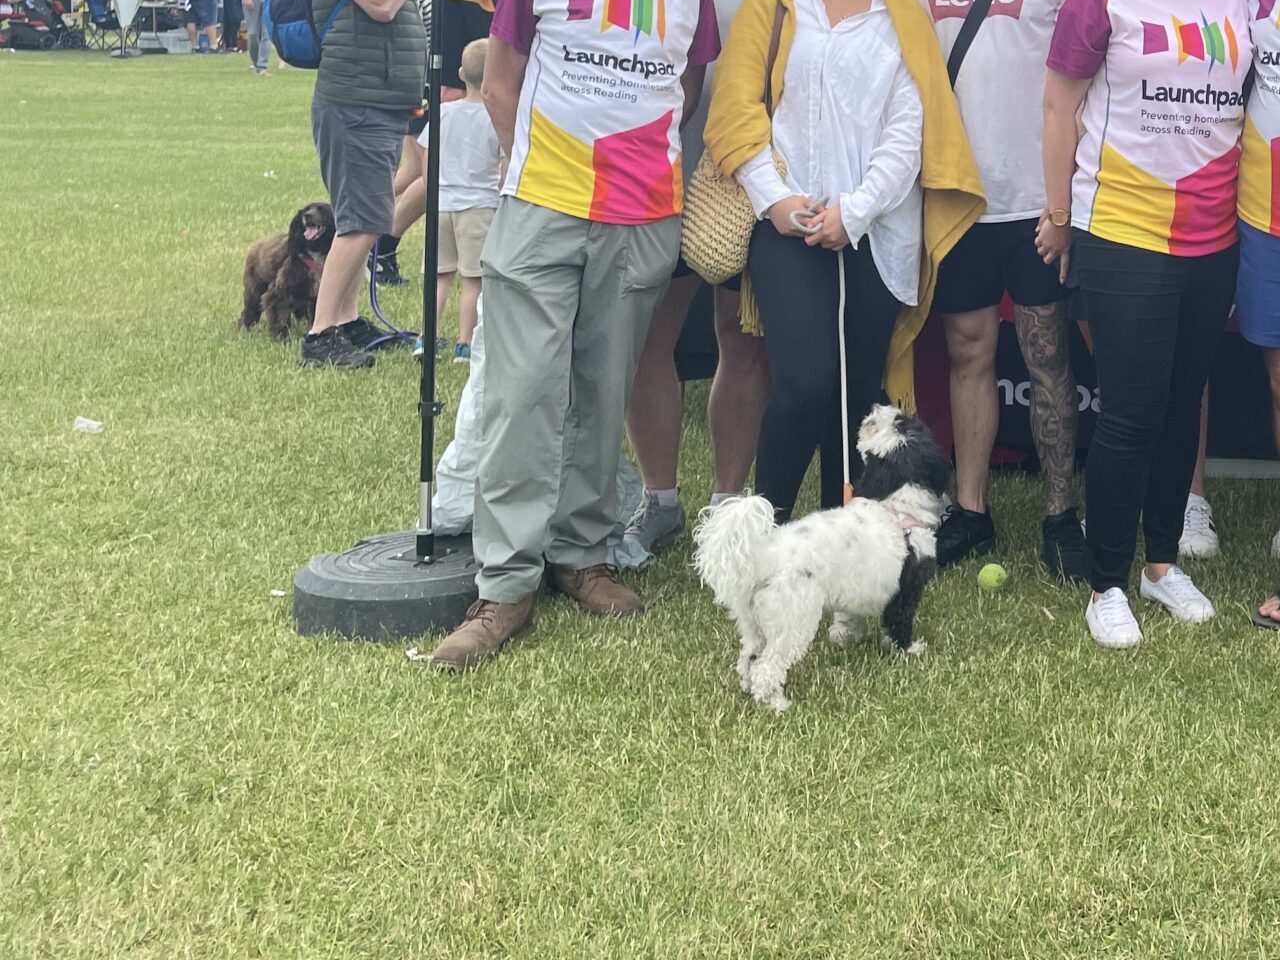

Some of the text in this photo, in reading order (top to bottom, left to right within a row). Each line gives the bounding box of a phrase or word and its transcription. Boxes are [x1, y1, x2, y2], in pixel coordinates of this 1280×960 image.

[561, 70, 616, 88] Preventing
[594, 86, 638, 103] Reading
[1141, 109, 1191, 124] Preventing
[1140, 124, 1211, 138] across Reading
